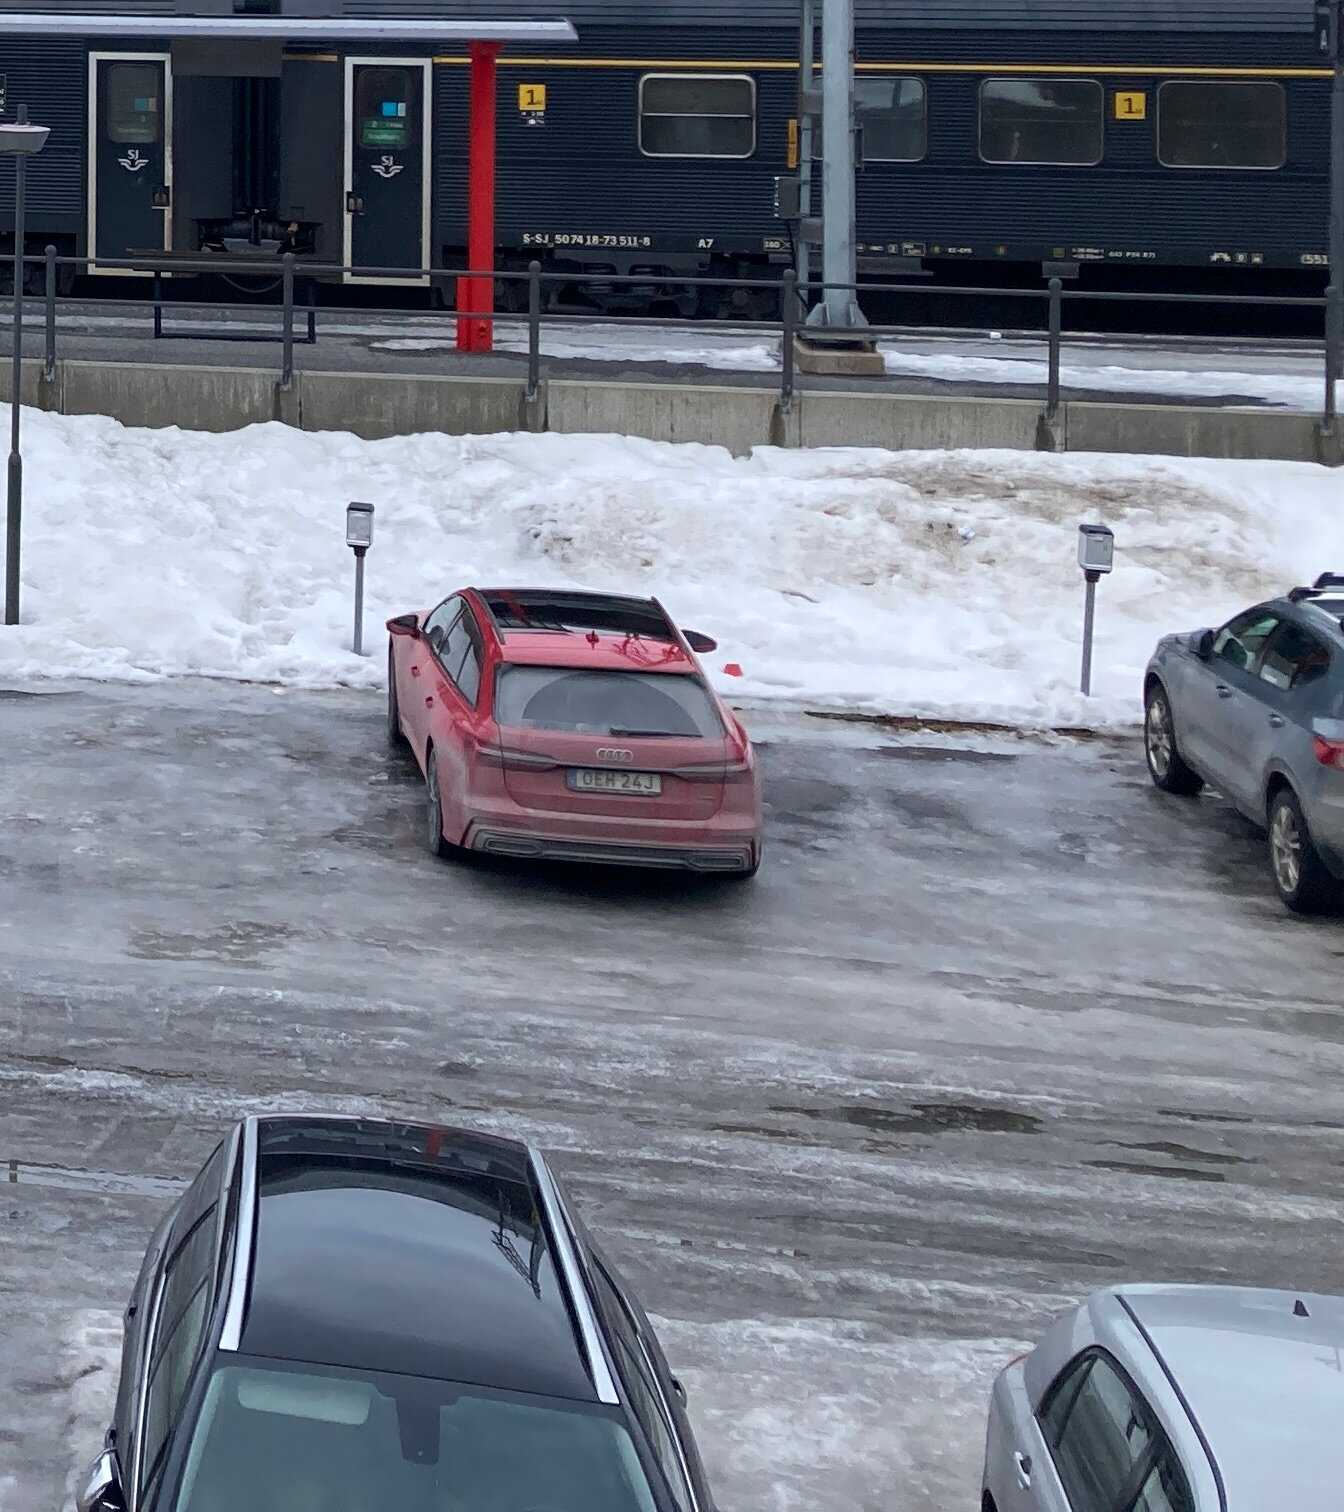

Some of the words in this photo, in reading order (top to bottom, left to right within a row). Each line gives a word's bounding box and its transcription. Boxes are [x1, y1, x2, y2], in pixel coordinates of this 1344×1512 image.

[127, 149, 140, 161] SJ
[381, 155, 394, 167] SJ
[698, 238, 714, 249] A7
